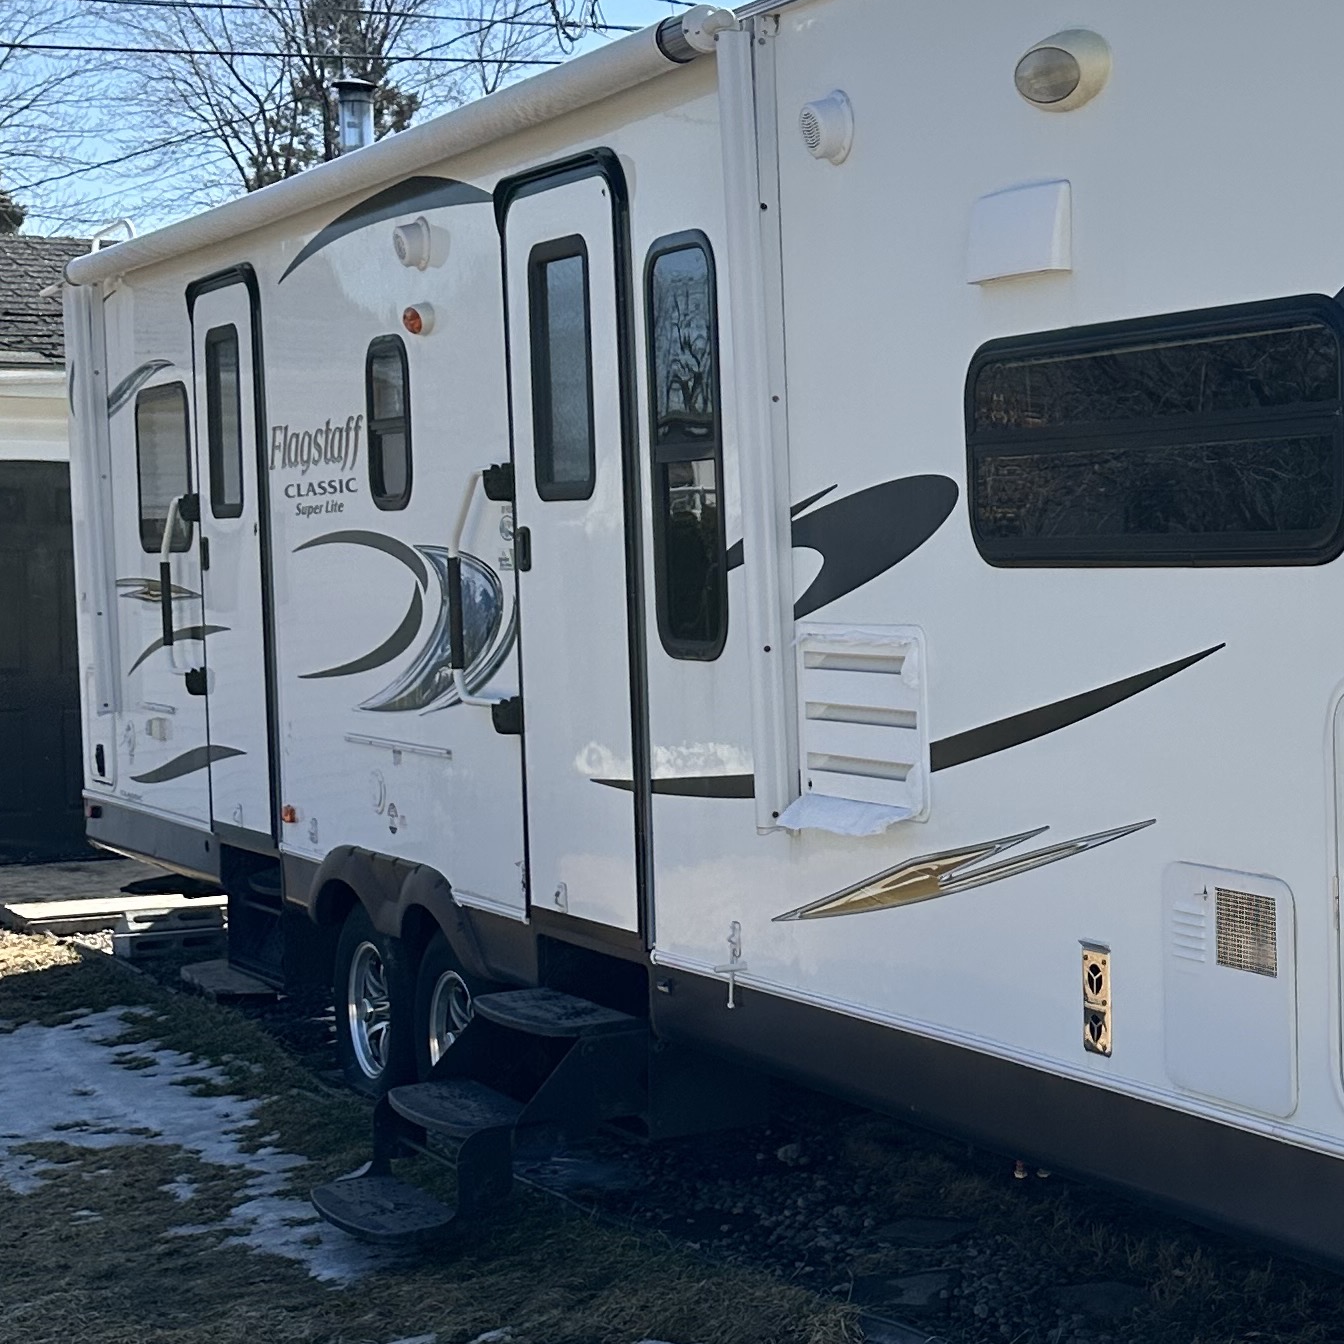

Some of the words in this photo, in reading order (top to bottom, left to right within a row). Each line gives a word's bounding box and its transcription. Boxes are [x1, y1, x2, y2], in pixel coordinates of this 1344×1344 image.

[269, 414, 364, 476] Flagstaff
[284, 477, 358, 498] CLASSIC
[296, 502, 323, 518] Super
[325, 499, 344, 514] Lite
